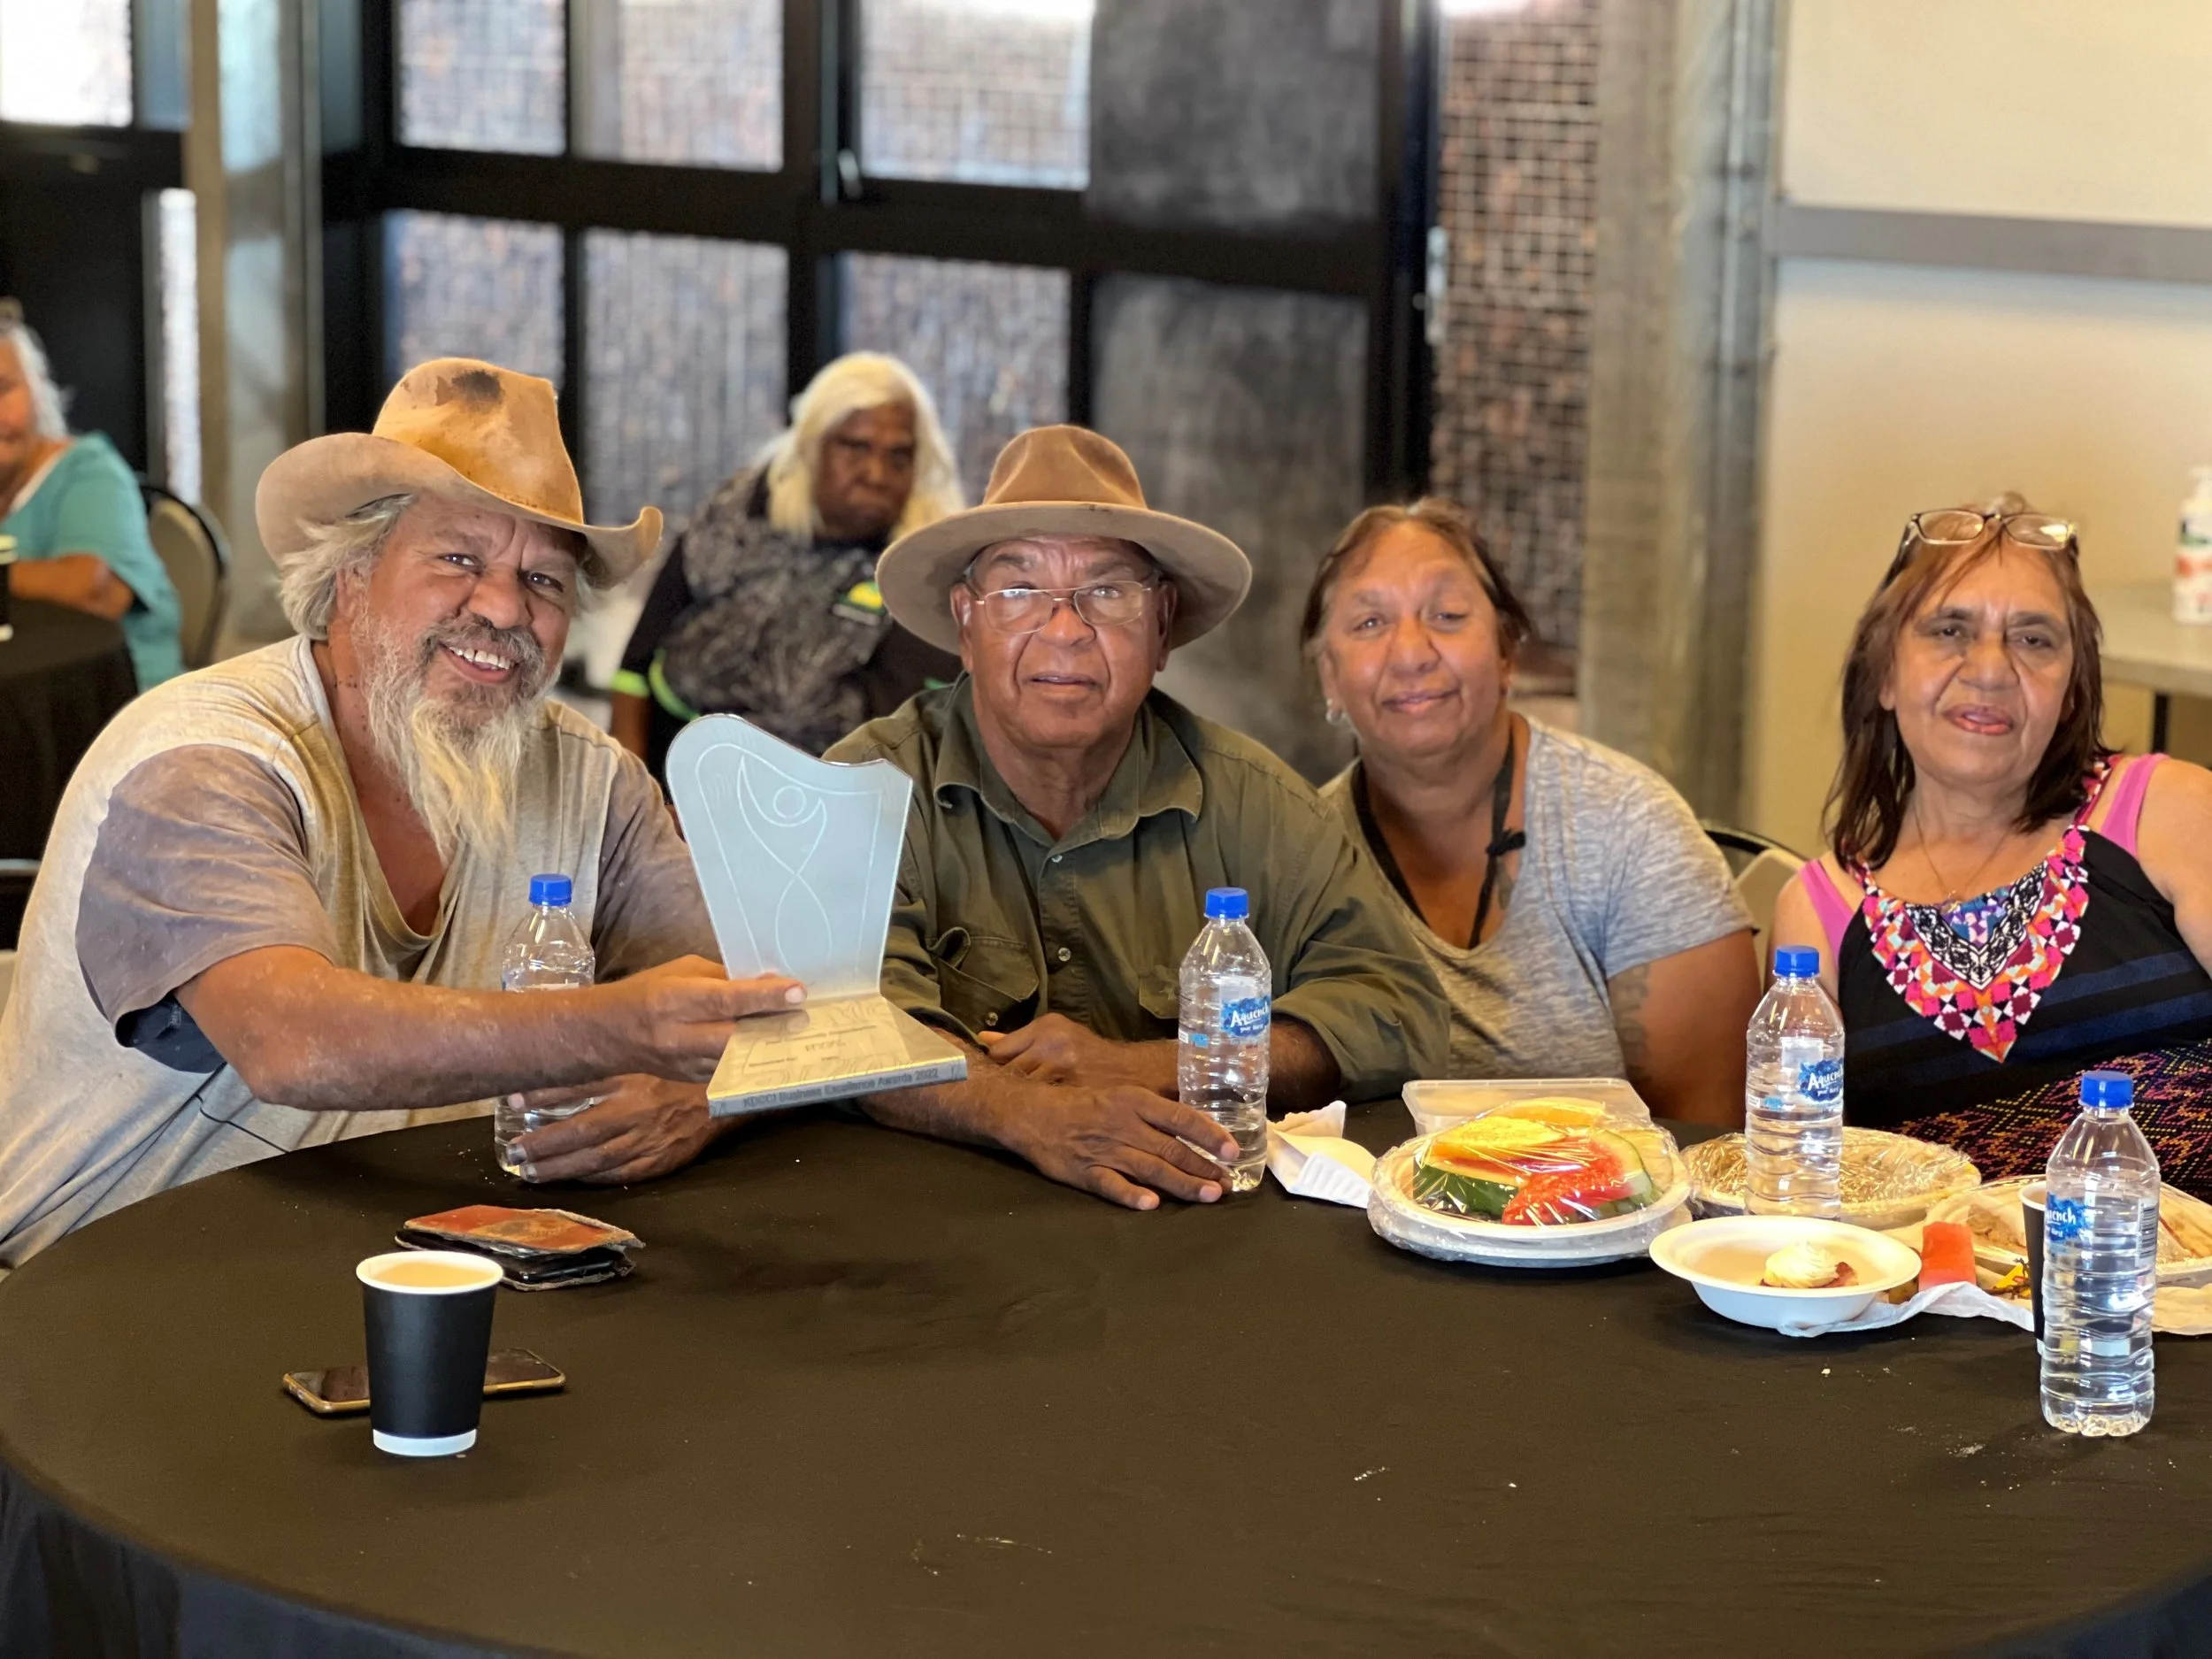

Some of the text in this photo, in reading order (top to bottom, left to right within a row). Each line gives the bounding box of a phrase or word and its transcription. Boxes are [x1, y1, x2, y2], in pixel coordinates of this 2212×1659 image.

[779, 1087, 821, 1102] Business
[825, 1079, 875, 1094] Excellence
[876, 1073, 912, 1088] Awards
[915, 1068, 939, 1080] 2022
